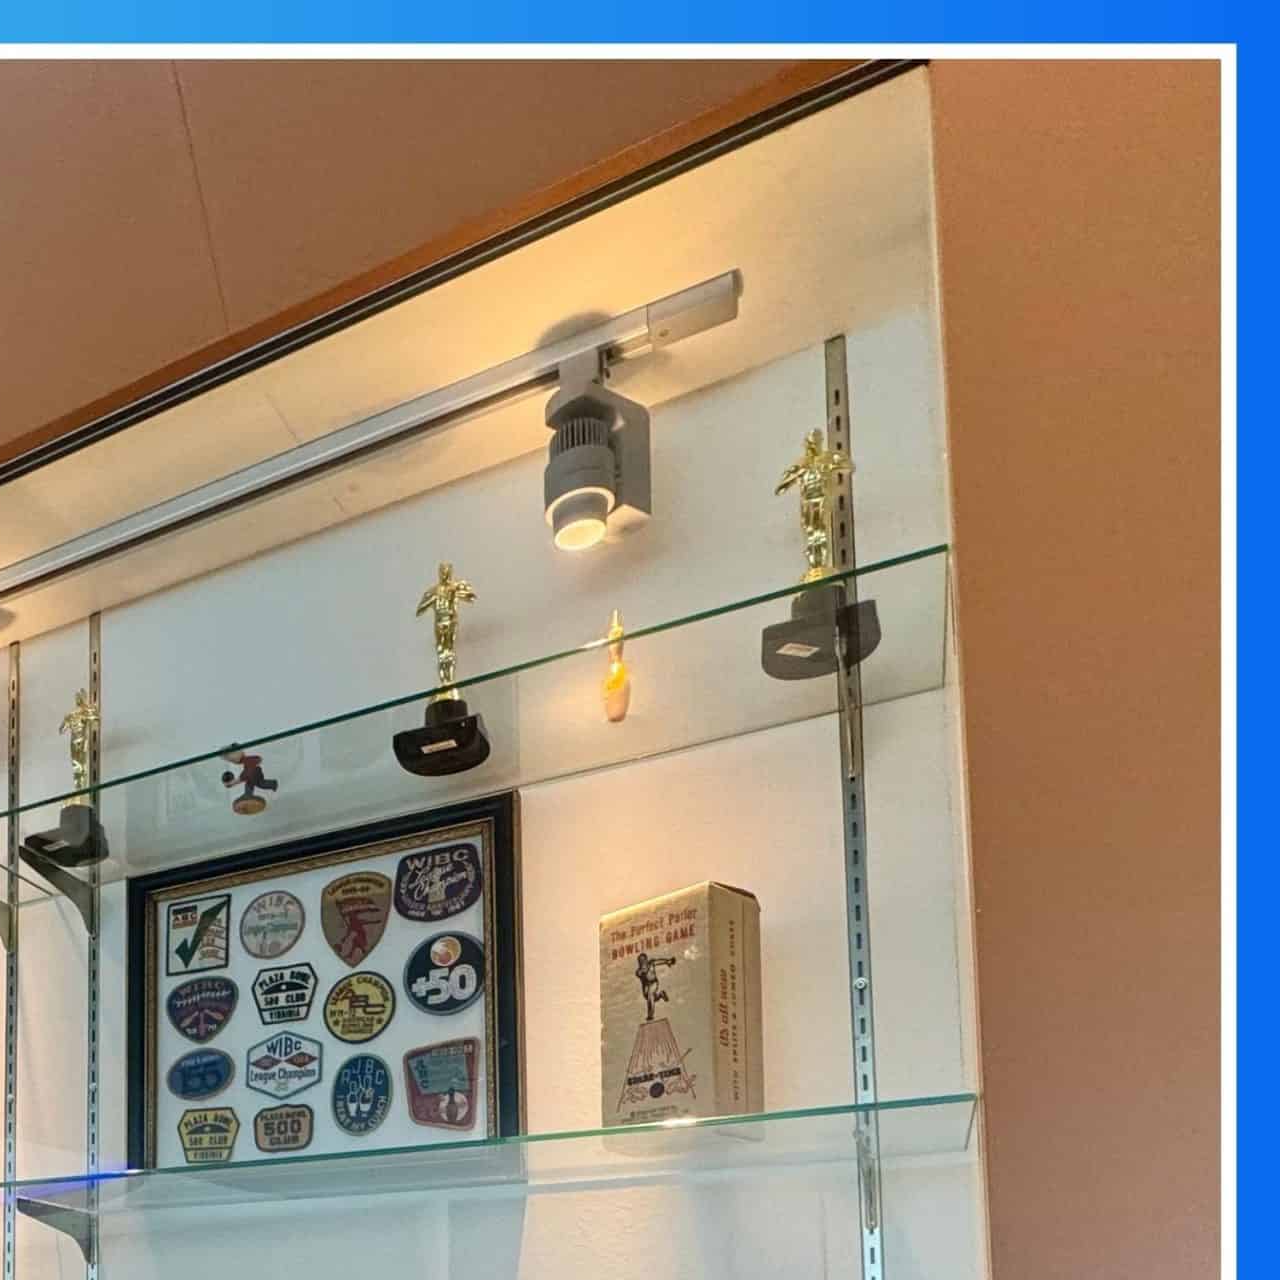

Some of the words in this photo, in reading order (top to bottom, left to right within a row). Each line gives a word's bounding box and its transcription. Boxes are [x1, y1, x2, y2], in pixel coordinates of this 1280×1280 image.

[406, 849, 469, 871] WIBC
[611, 935, 659, 960] BOWLING
[665, 923, 696, 944] GAME
[259, 971, 284, 990] PLAZA
[266, 1036, 303, 1058] WIBC
[264, 1119, 302, 1137] 500
